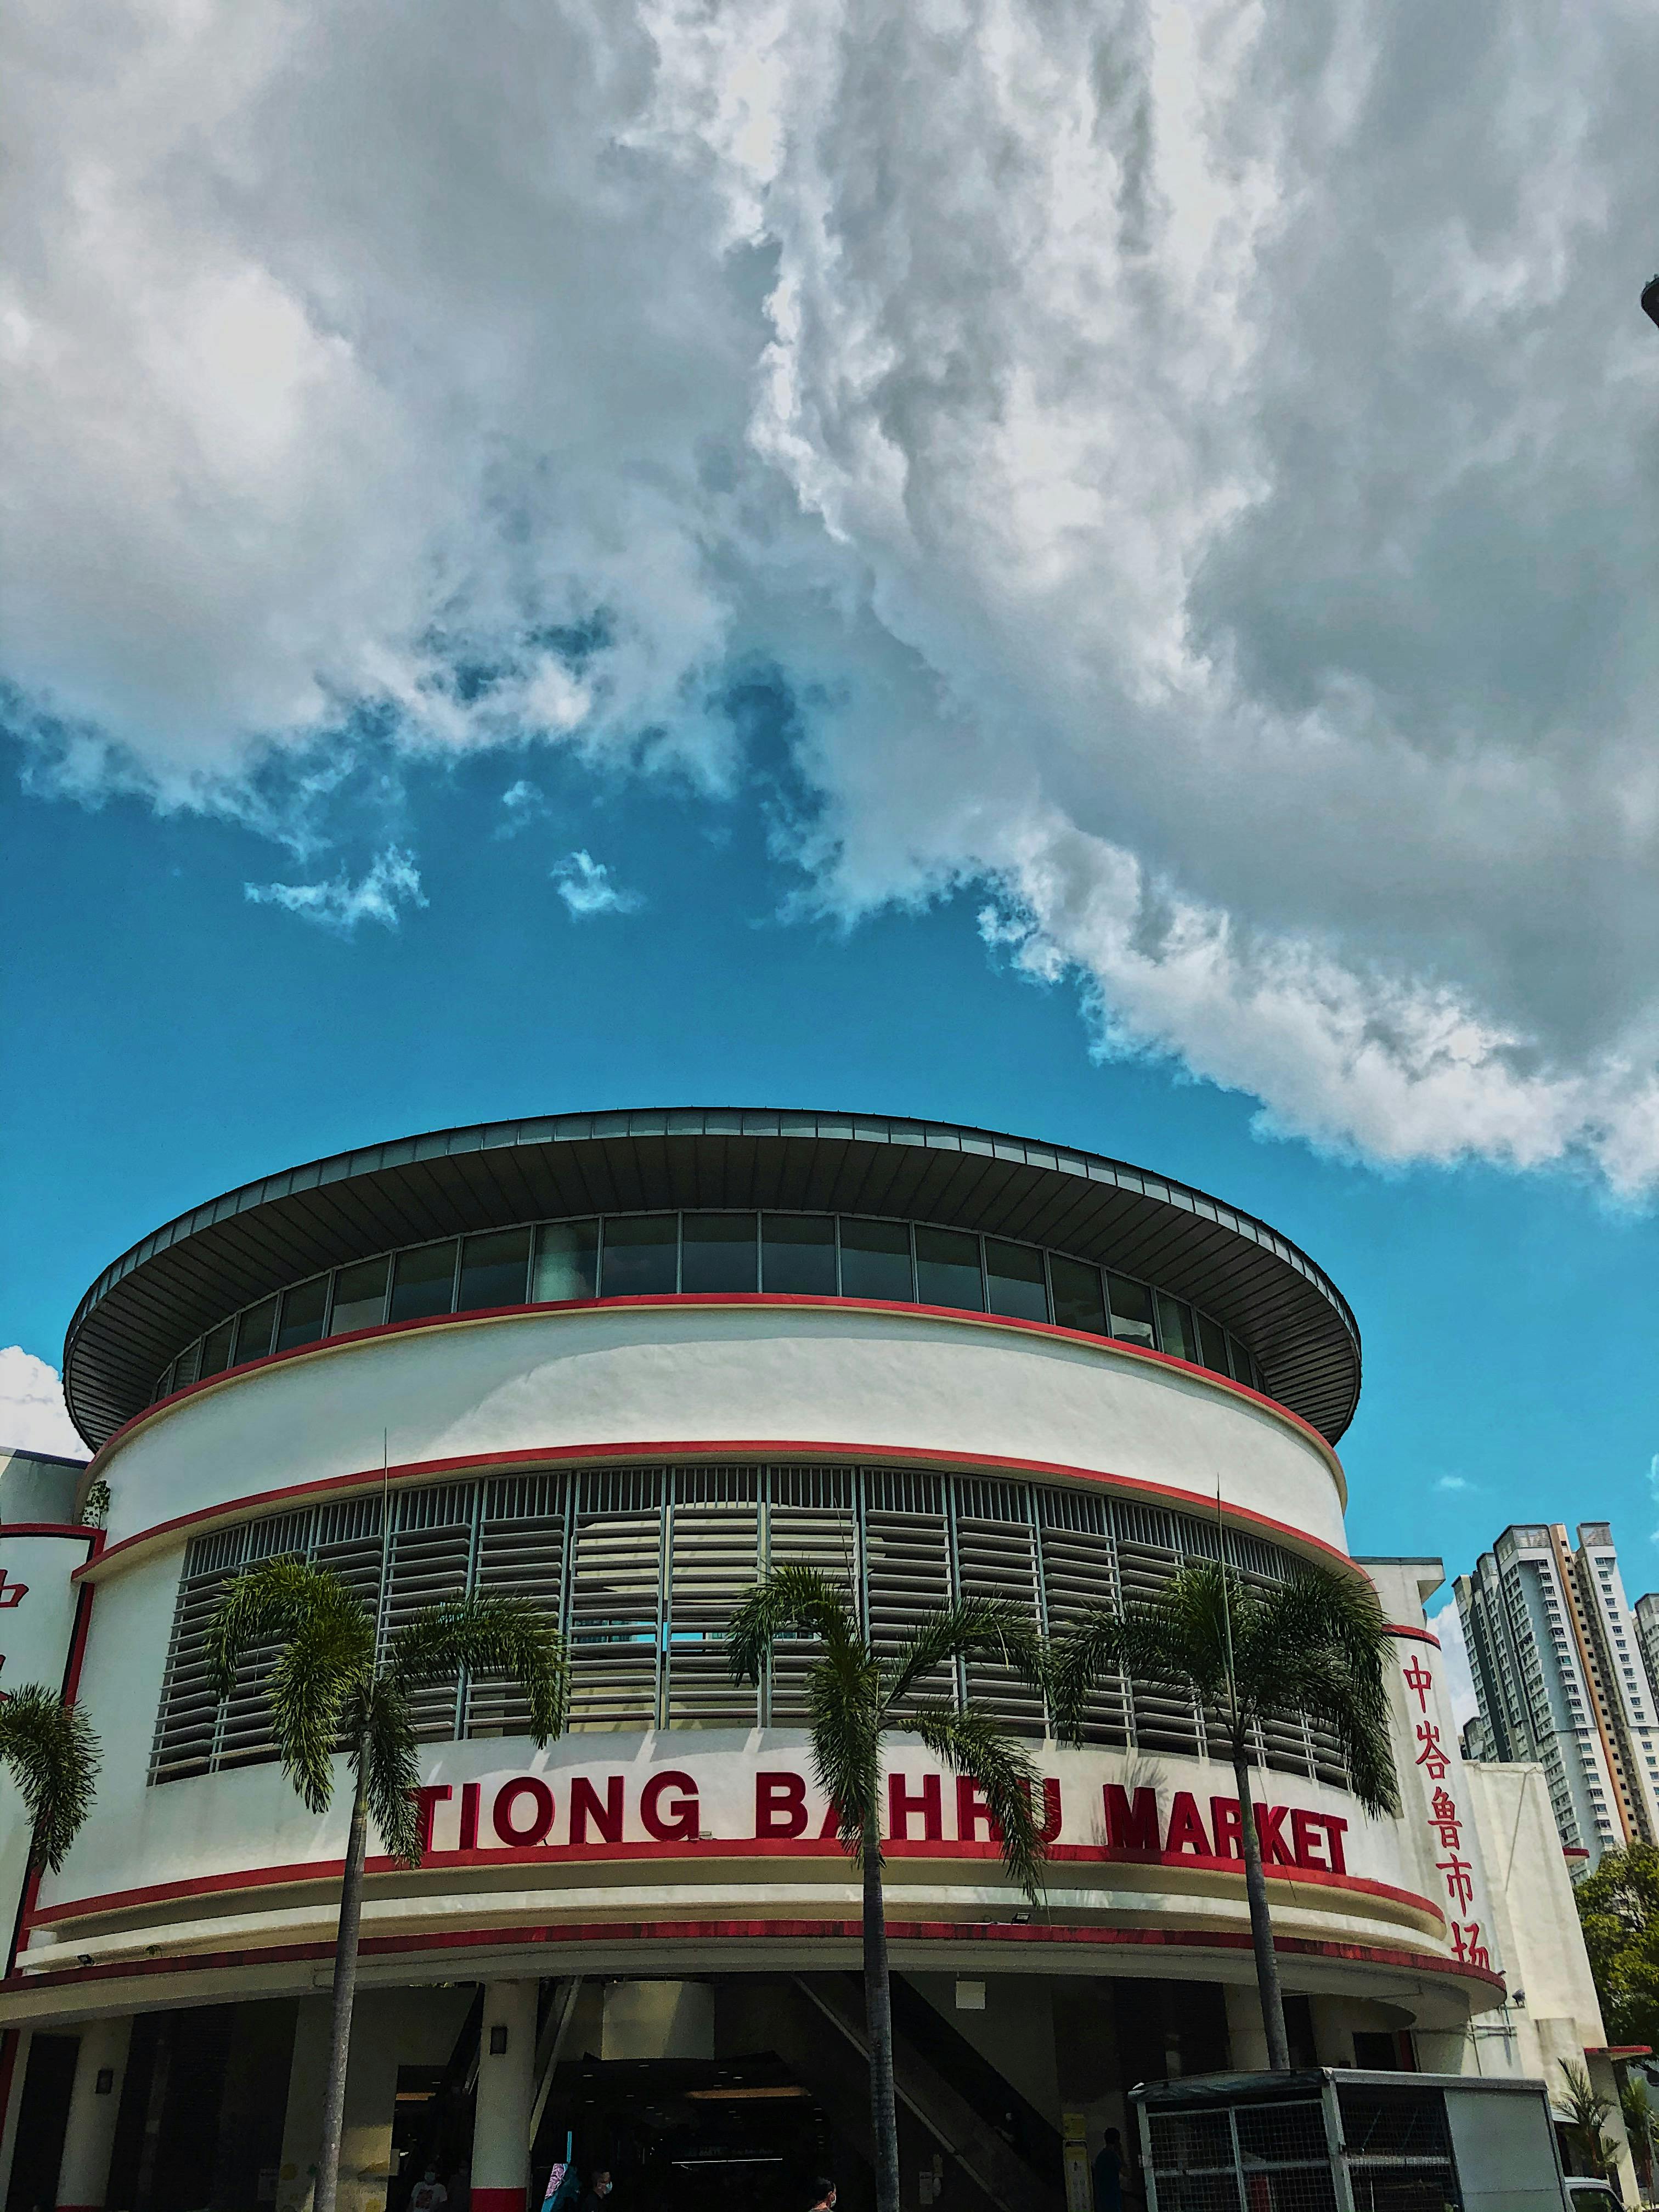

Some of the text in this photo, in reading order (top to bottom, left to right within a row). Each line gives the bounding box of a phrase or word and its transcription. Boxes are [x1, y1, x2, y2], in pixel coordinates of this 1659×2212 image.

[402, 1770, 700, 1853] TIONG
[1103, 1783, 1348, 1875] MARKET
[1403, 1655, 1490, 1971] 中峇鲁市场
